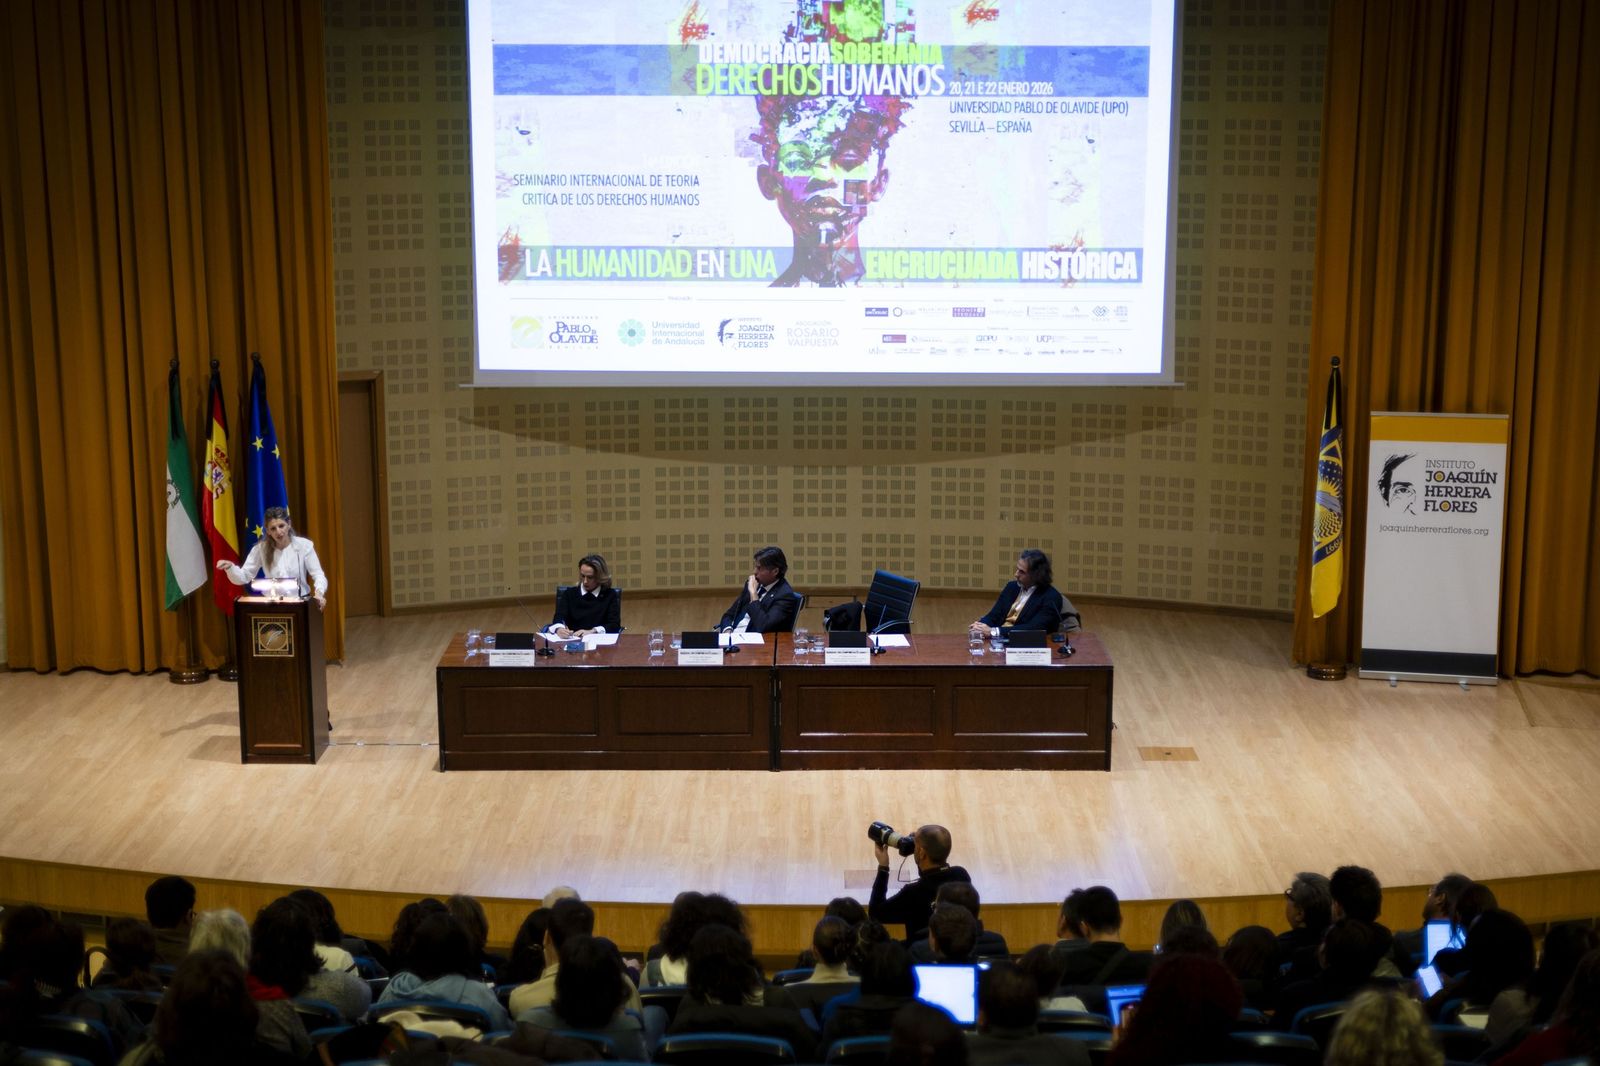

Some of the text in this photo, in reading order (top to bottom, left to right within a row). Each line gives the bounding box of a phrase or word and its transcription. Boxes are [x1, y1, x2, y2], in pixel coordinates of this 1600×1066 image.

[949, 81, 1053, 96] 20, 21 E 22 ENERO 2026
[949, 101, 1129, 116] UNIVERSIDAD PABLO DE OLAVIDE (UPO)
[949, 121, 985, 133] SEVILLA
[996, 118, 1032, 133] ESPAÑA
[513, 174, 700, 187] SEMINARIO INTERNACIONAL DE TEORIA
[522, 194, 700, 206] CRITICA DE LOS DERECHOS HUMANOS
[525, 249, 552, 278] LA
[556, 249, 692, 278] HUMANIDAD
[696, 249, 724, 278] EN
[729, 249, 777, 278] UNA
[1022, 247, 1137, 280] HISTÓRICA
[556, 321, 591, 334] PABLO
[652, 321, 700, 329] Universidad
[738, 324, 775, 332] JOAQUÍN
[549, 332, 599, 344] OLAVIDE
[652, 329, 705, 337] Internacional
[787, 328, 839, 338] ROSARIO
[788, 338, 839, 347] VALPUESTA
[1425, 459, 1475, 469] INSTITUTO
[1425, 469, 1498, 485] JOAQUÍN
[1424, 485, 1492, 499] HERRERA
[1423, 500, 1478, 514] FLORES
[1379, 523, 1490, 537] joaquinherreraflores.org
